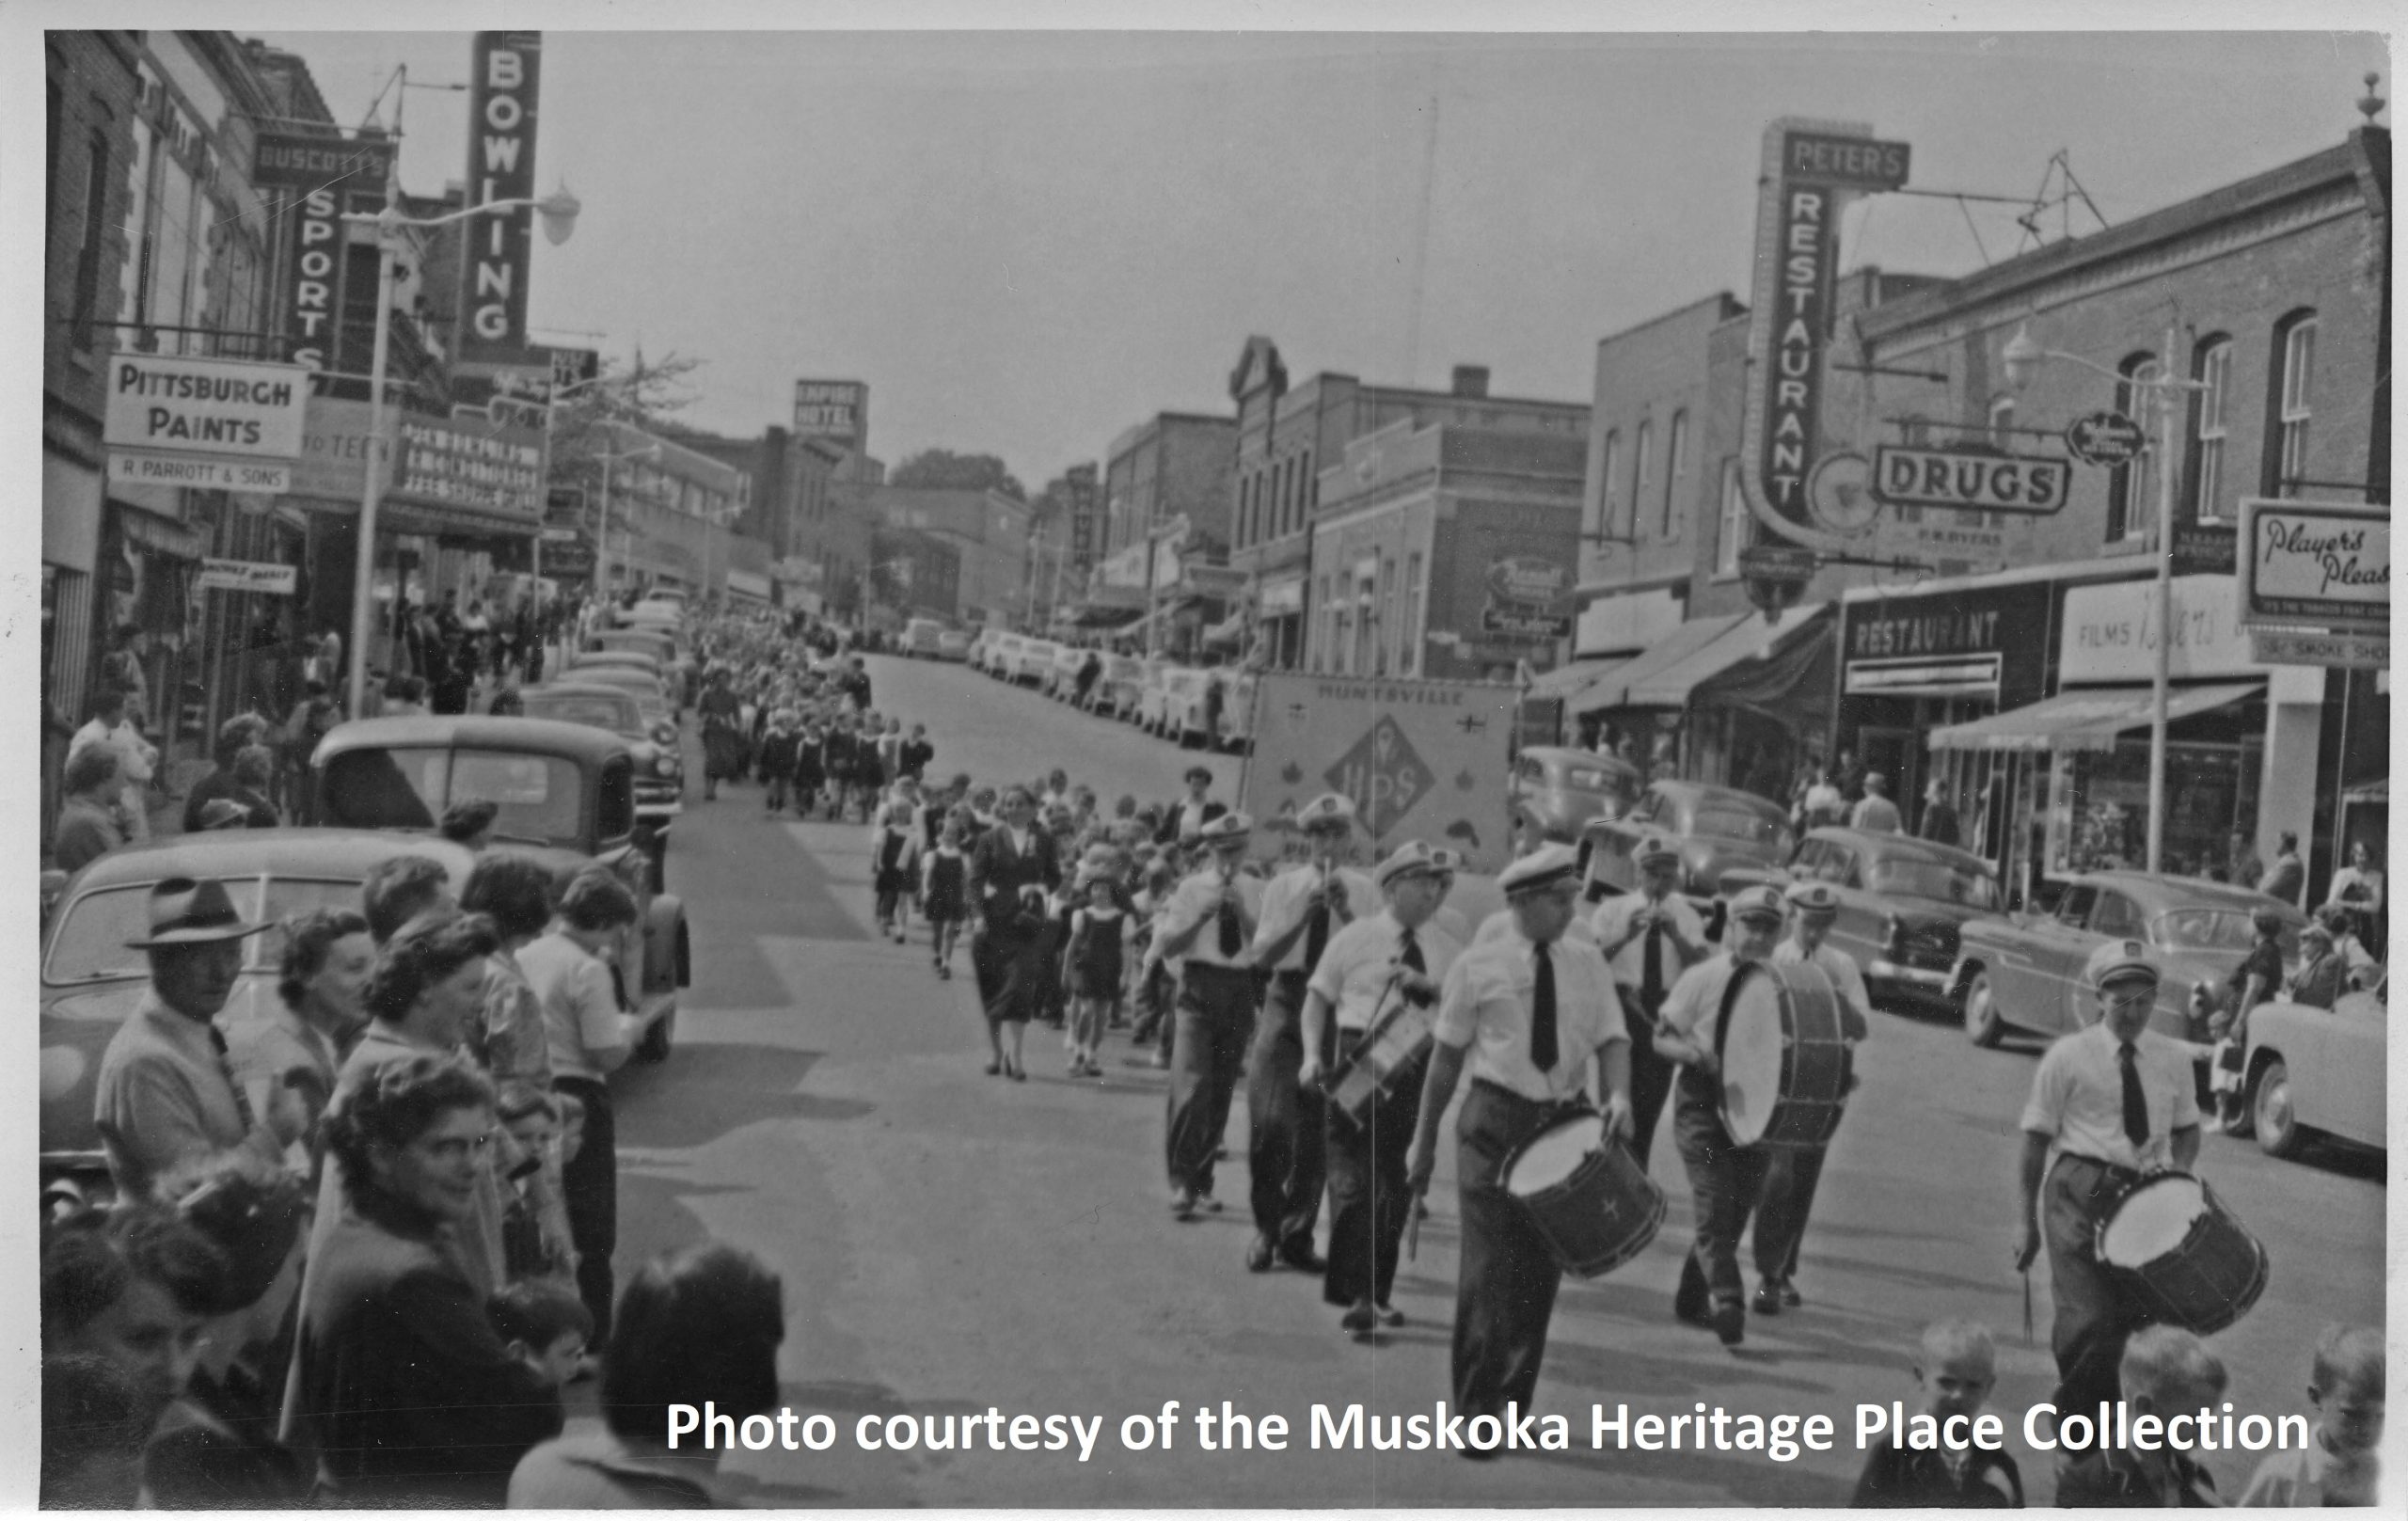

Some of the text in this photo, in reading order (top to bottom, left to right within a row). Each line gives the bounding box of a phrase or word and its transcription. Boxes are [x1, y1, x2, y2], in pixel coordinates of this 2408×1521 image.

[475, 50, 523, 340] BOWLING
[293, 190, 335, 372] SPORTS
[1773, 193, 1822, 503] RESTAURANT
[119, 364, 292, 406] PITTSBURGH
[148, 406, 261, 445] PAINTS
[142, 461, 216, 482] PARROTT
[223, 468, 233, 483] &
[241, 468, 282, 487] SONS
[1888, 455, 2056, 504] DRUGS
[1855, 610, 2001, 655] RESTAURANT
[2078, 621, 2131, 648] FILMS
